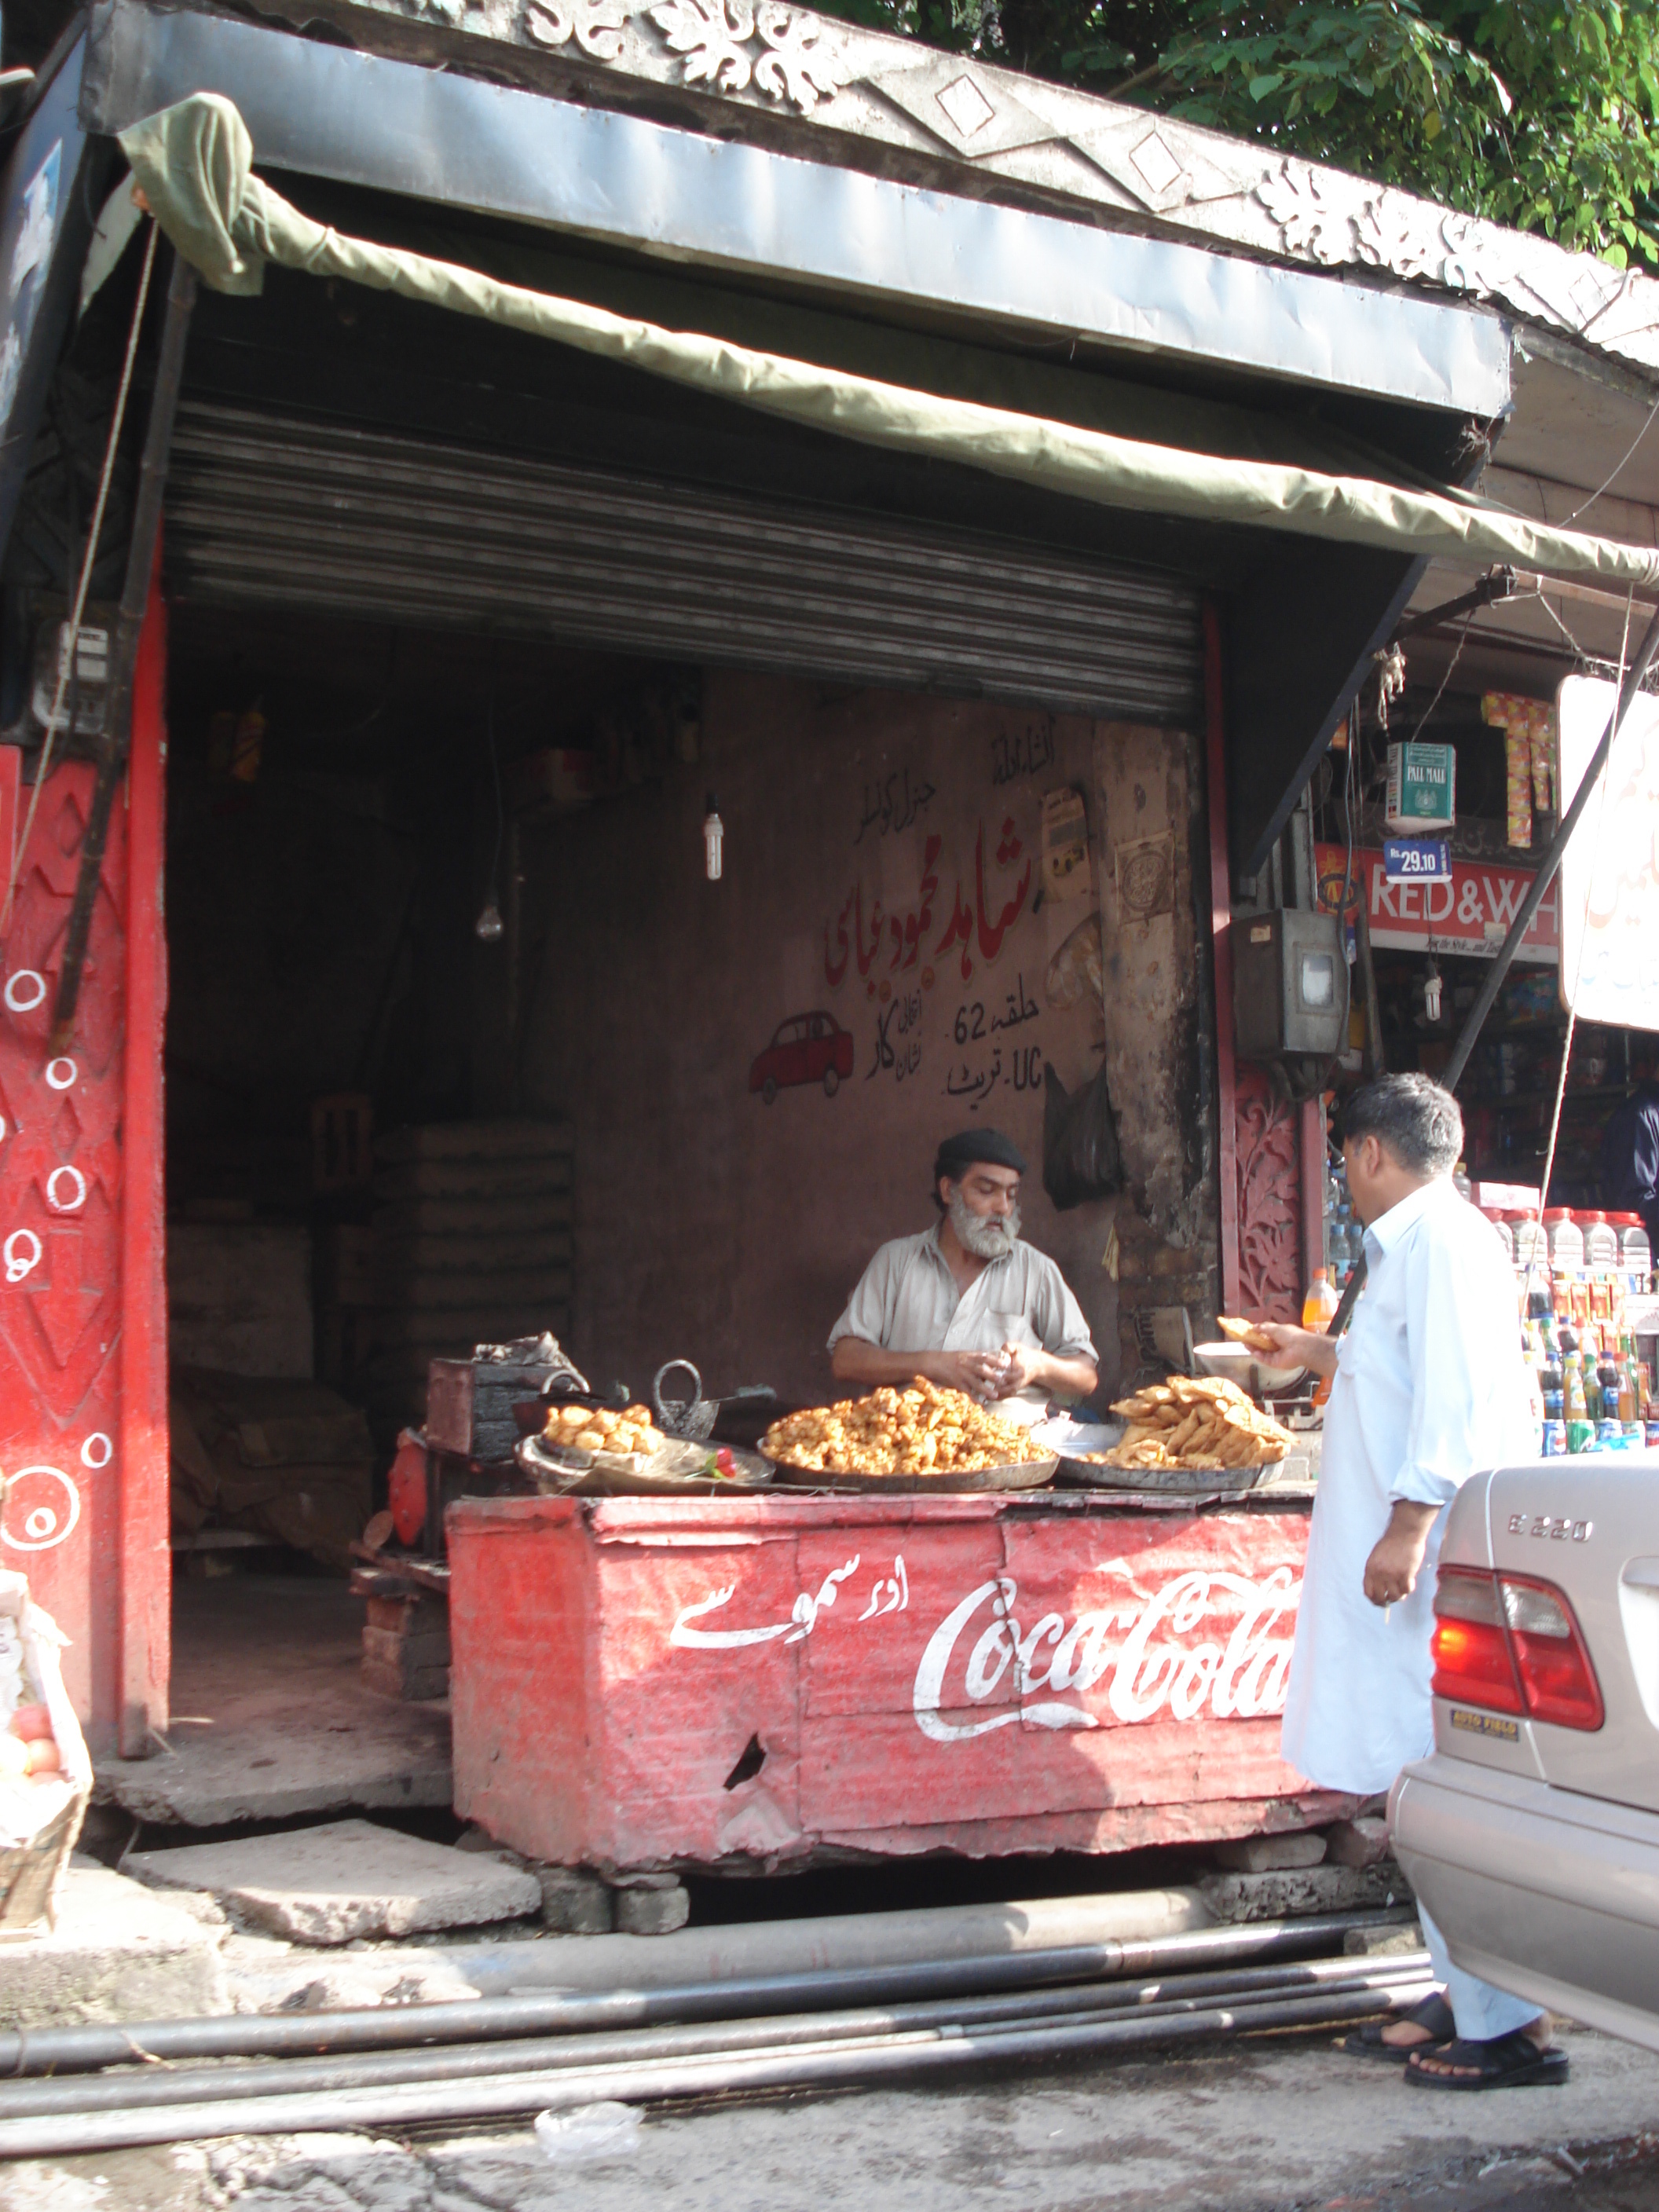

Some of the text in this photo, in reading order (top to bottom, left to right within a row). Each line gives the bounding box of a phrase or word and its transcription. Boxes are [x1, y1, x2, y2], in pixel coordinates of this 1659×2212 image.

[1407, 765, 1446, 785] PALL MALL
[1401, 850, 1436, 873] 29.10
[888, 833, 943, 970] محمود
[933, 815, 1031, 980] شاہد
[954, 1001, 987, 1046] 62
[1508, 1513, 1594, 1543] E 220
[669, 1552, 910, 1650] اور سموسے
